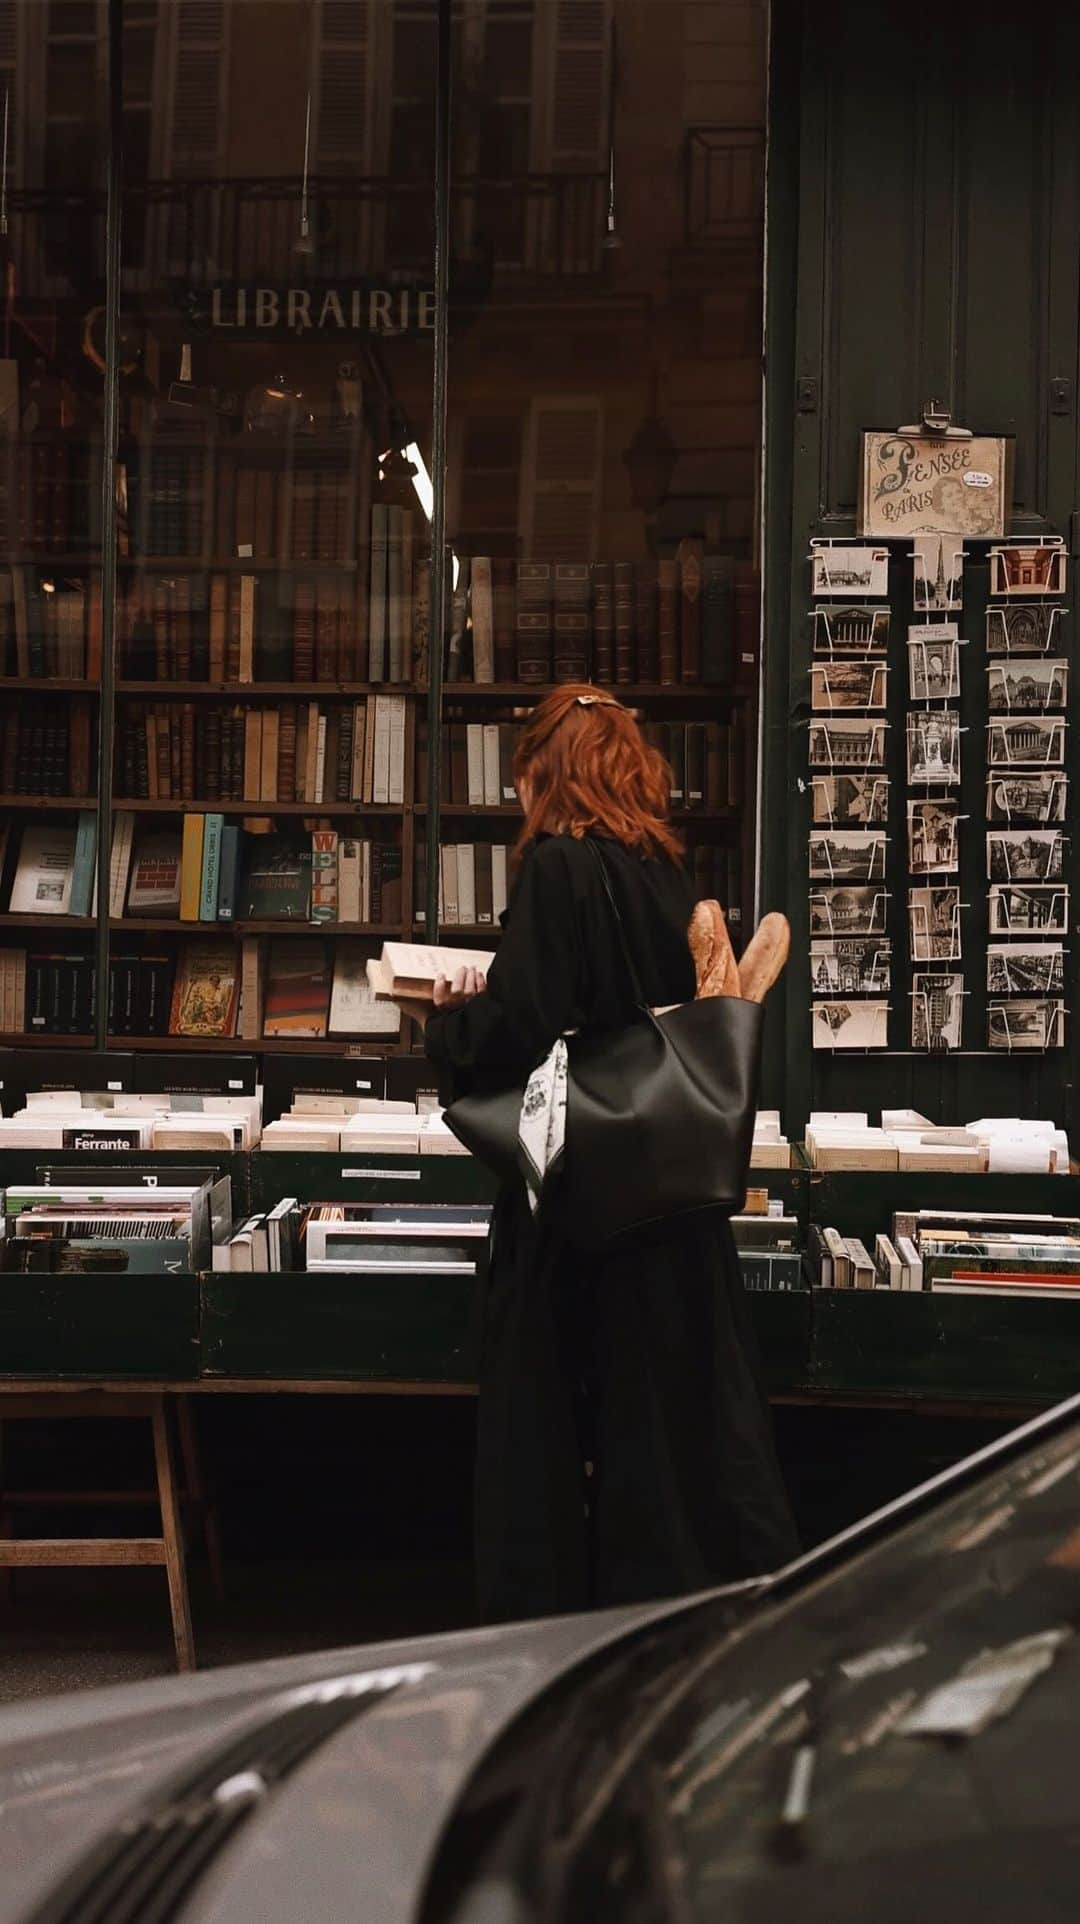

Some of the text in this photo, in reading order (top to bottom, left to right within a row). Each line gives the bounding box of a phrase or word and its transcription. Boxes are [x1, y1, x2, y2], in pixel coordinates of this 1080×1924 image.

[211, 288, 436, 329] LIBRAIRIE
[882, 490, 933, 522] PARIS
[74, 1138, 130, 1150] Ferrante
